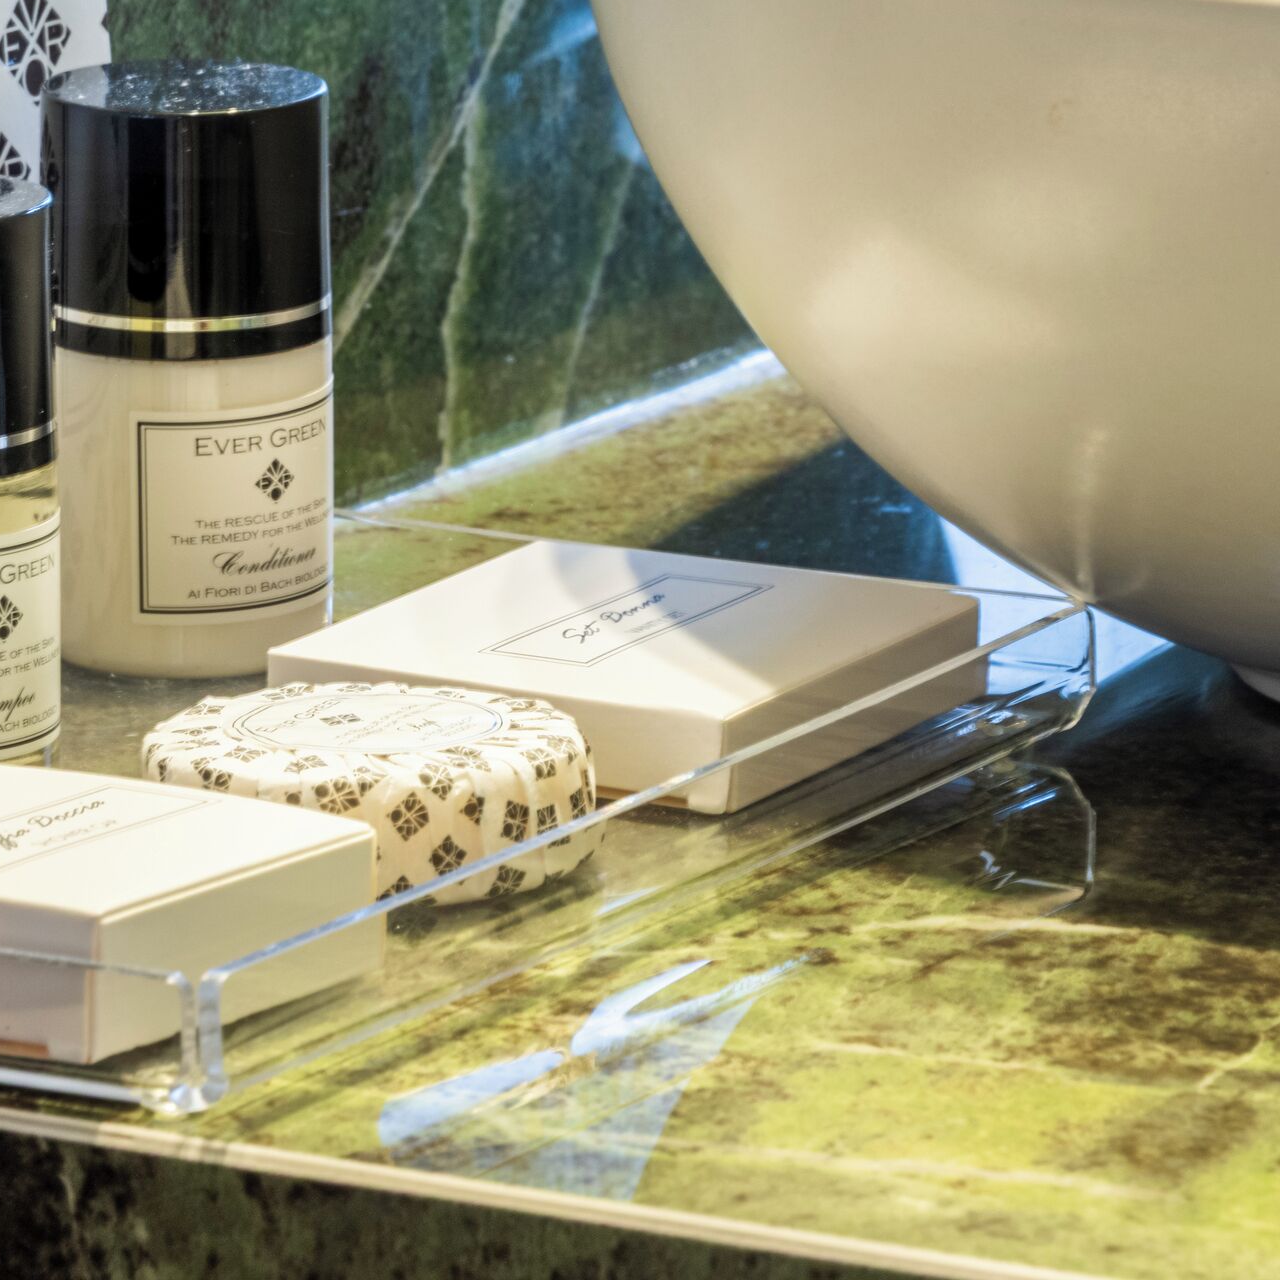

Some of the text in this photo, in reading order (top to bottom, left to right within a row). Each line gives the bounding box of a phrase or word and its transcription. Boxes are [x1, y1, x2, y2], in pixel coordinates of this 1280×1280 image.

[195, 436, 262, 457] EVER
[195, 519, 221, 530] THE
[225, 511, 279, 529] RESCUE
[282, 507, 296, 520] OF
[171, 535, 197, 546] THE
[201, 528, 259, 545] REMEDY
[262, 526, 284, 539] FOR
[212, 546, 317, 576] Conditioner
[205, 587, 241, 599] FIORI
[245, 585, 257, 595] DI
[260, 578, 292, 593] BACH
[562, 593, 666, 644] Set Donna
[9, 648, 23, 660] OF
